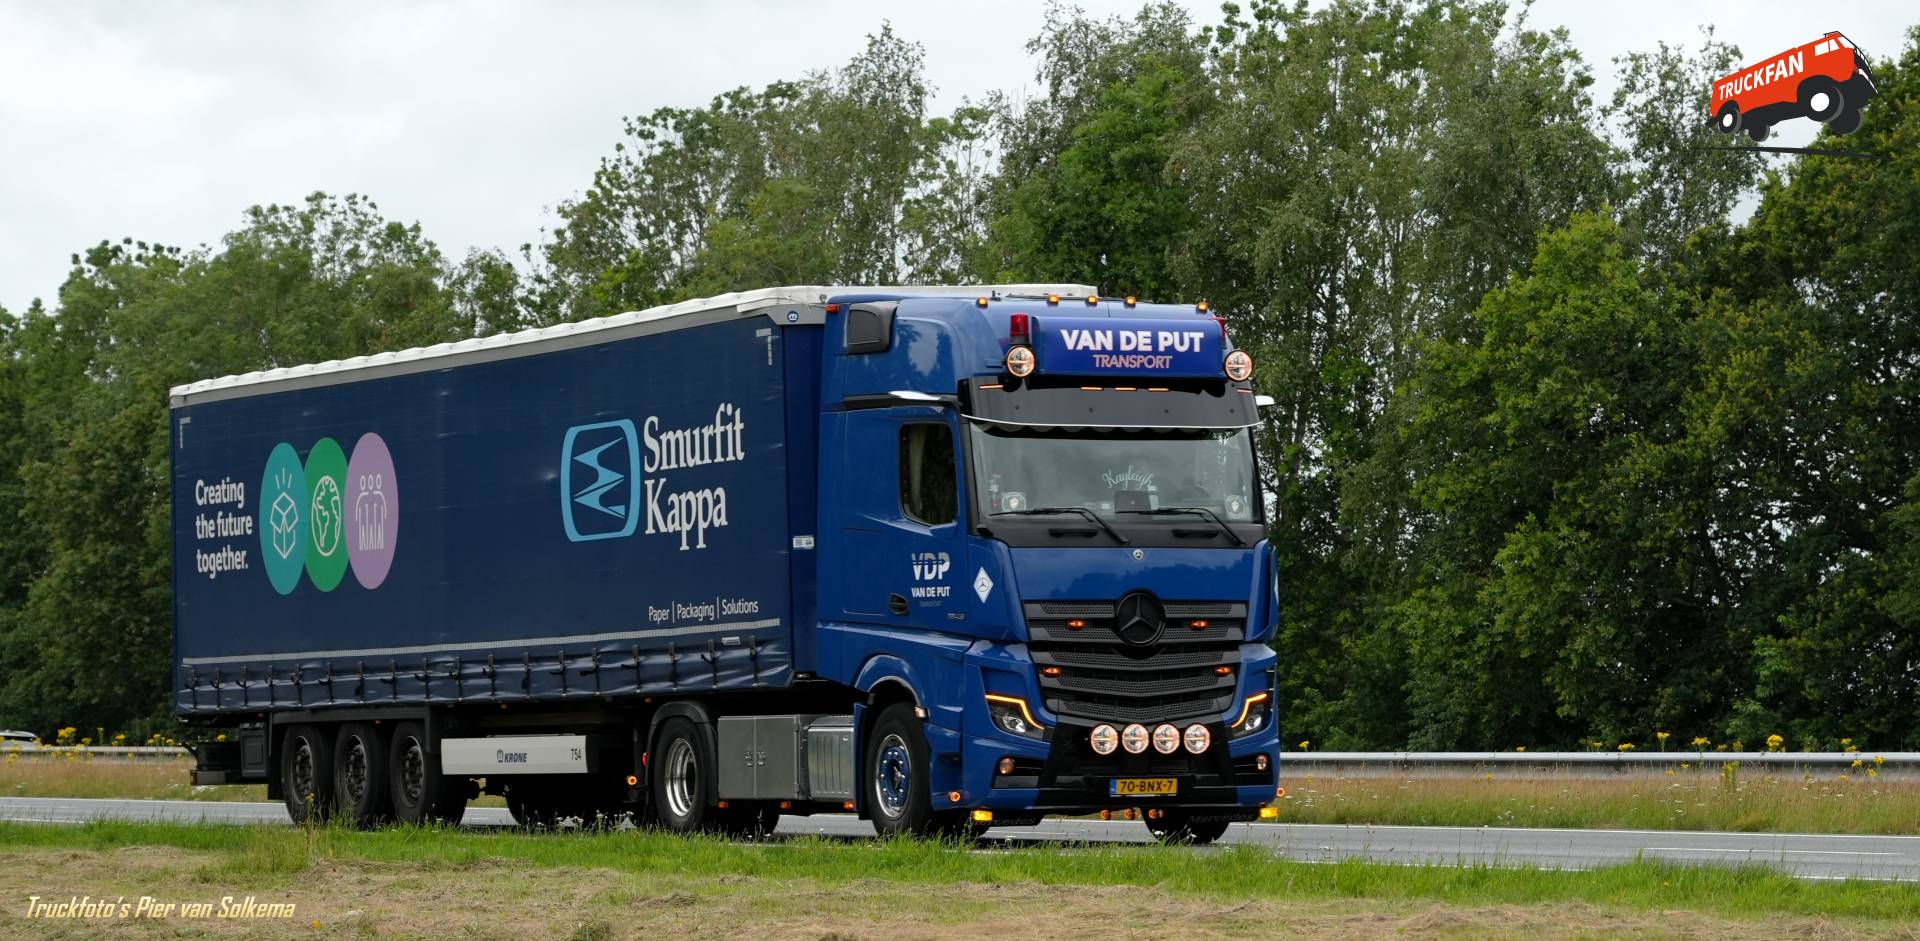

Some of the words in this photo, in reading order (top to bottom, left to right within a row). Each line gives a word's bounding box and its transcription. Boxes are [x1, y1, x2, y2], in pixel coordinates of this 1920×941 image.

[1060, 329, 1113, 351] VAN
[1119, 330, 1152, 351] DE
[1158, 331, 1205, 352] PUT
[1093, 354, 1173, 369] TRANSPORT
[643, 402, 745, 474] Smurfit
[1102, 464, 1153, 489] Kayleigh
[195, 477, 245, 509] Creating
[196, 514, 216, 540] the
[216, 511, 253, 538] future
[644, 477, 728, 551] Kappa
[196, 545, 249, 580] together.
[911, 552, 950, 581] VDP
[911, 587, 925, 598] VAN
[926, 587, 936, 597] DE
[937, 586, 951, 597] PUT
[648, 606, 670, 624] Paper
[677, 601, 715, 621] Packaging
[722, 598, 759, 615] Solutions
[504, 752, 527, 763] KRONE
[1120, 780, 1173, 792] 70-BNX-7
